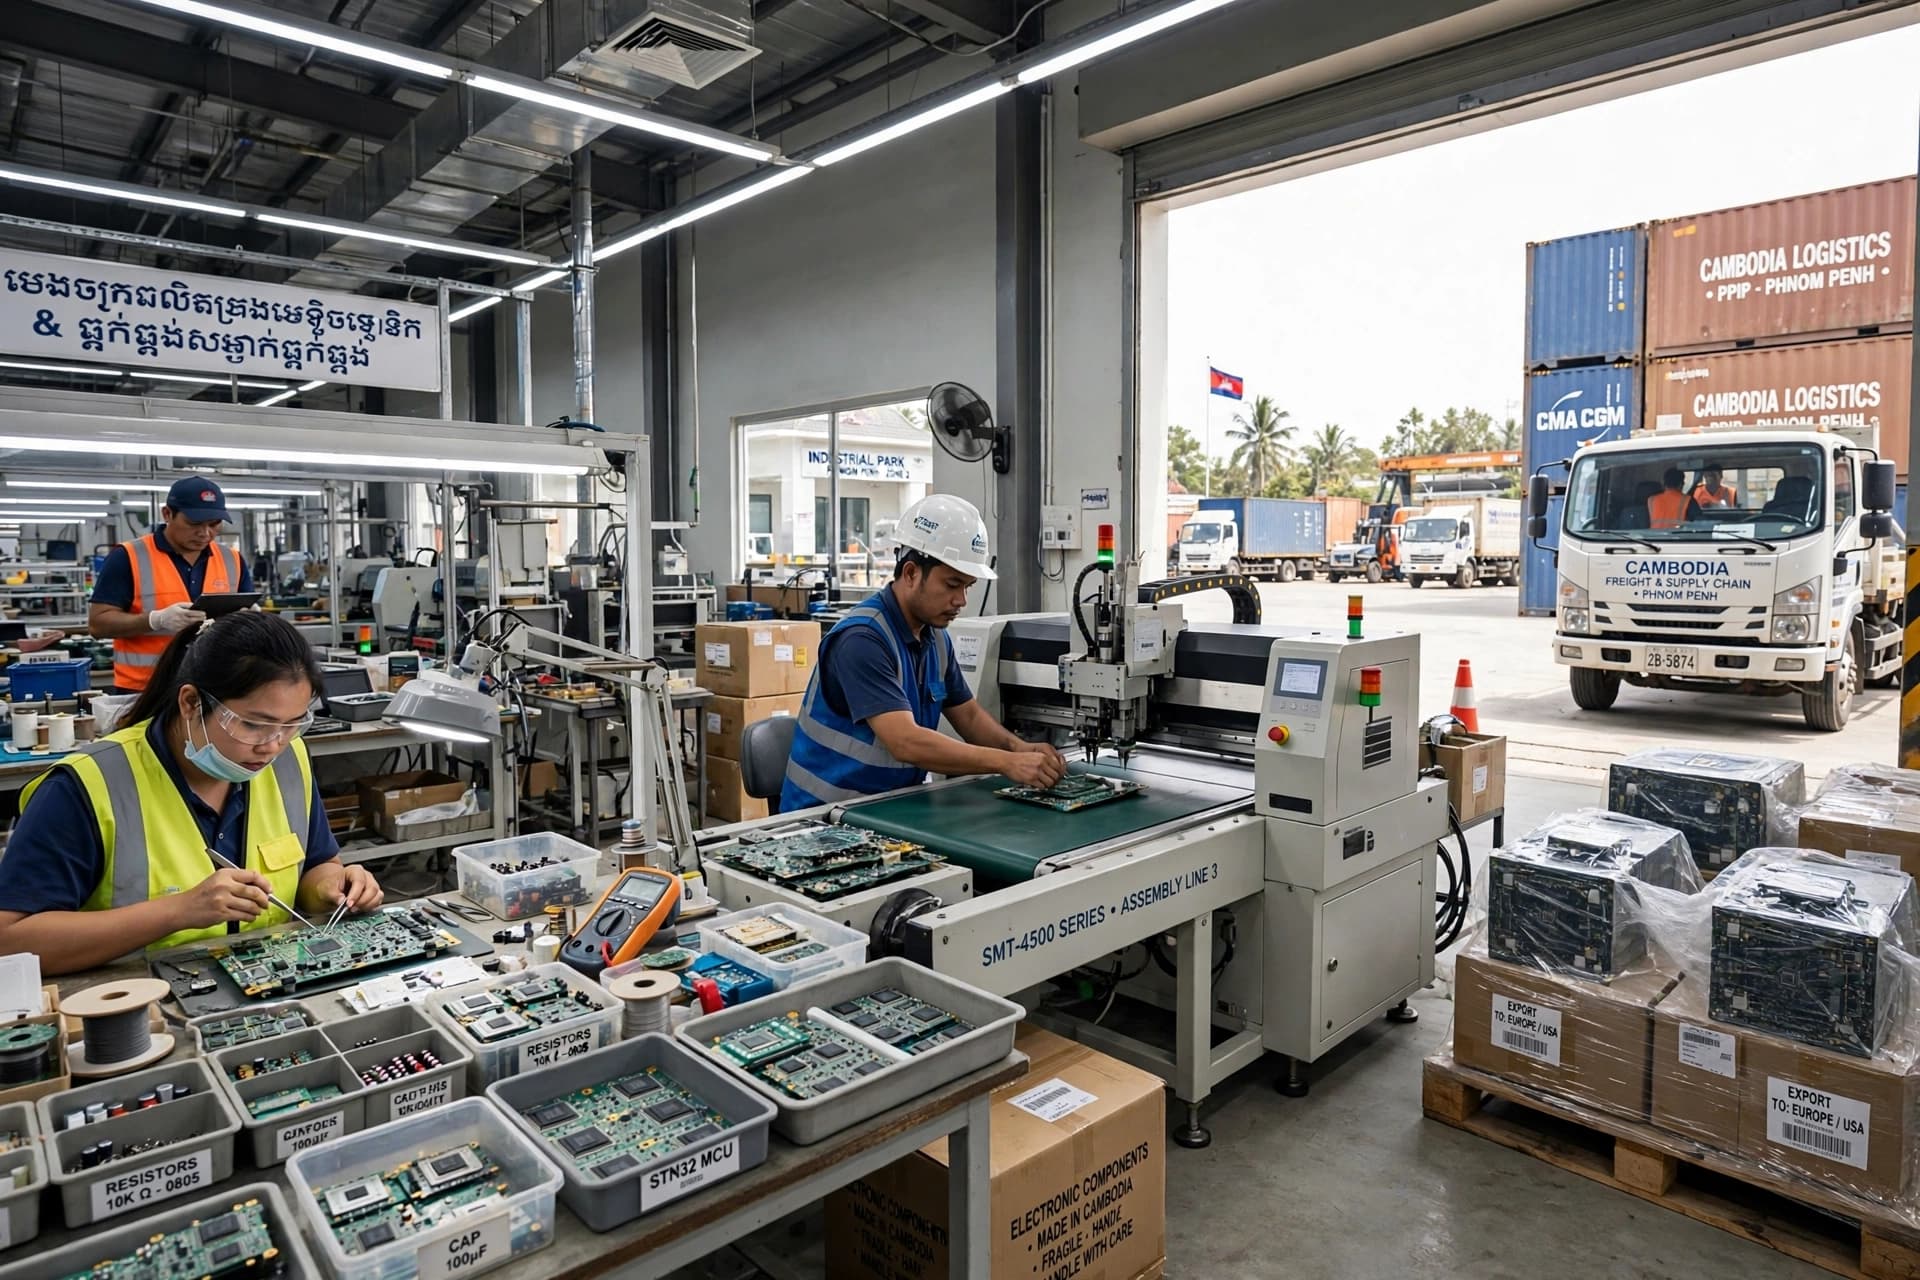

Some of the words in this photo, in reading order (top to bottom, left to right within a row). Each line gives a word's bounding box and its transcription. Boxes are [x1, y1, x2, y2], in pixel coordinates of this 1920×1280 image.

[1699, 247, 1788, 283] CAMBODIA
[1793, 231, 1892, 270] LOGISTICS
[1717, 281, 1751, 302] PPIP
[1765, 271, 1824, 295] PHNOM
[1828, 264, 1875, 288] PENH
[32, 308, 63, 338] &
[1693, 389, 1779, 417] CAMBODIA
[1784, 381, 1881, 412] LOGISTICS
[1536, 409, 1578, 431] CMA
[1580, 405, 1625, 428] CGM
[808, 451, 874, 466] INDSTRIAL
[877, 455, 905, 467] PARK
[1605, 577, 1652, 587] FREIGHT
[1655, 578, 1663, 587] &
[1666, 578, 1710, 588] SUPPLY
[1713, 579, 1751, 589] CHAIN
[1625, 560, 1729, 576] CAMBODIA
[1642, 590, 1683, 600] PHNOM
[1686, 591, 1718, 600] PENH
[982, 924, 1054, 967] SMT-4500
[1059, 905, 1106, 938] SERIES
[1120, 877, 1183, 915] ASSEMBLY
[1185, 866, 1209, 890] LINE
[1211, 863, 1218, 879] 3
[527, 1028, 591, 1057] RESISTORS
[1507, 1014, 1537, 1031] EUROPE
[1542, 1024, 1558, 1038] USA
[1788, 1086, 1831, 1109] EXPORT
[1772, 1098, 1790, 1113] TO:
[1792, 1103, 1834, 1126] EUROPE
[1843, 1118, 1864, 1135] USA
[106, 1158, 198, 1195] RESISTORS
[650, 1158, 697, 1189] STN32
[701, 1142, 733, 1168] MCU
[106, 1191, 135, 1211] 10K
[165, 1171, 200, 1192] 0805
[1010, 1183, 1080, 1240] ELECTRONIC
[1083, 1141, 1149, 1196] COMPONENTS
[1037, 1216, 1068, 1251] MADE
[1070, 1208, 1080, 1229] IN
[1083, 1176, 1133, 1220] CAMBODIA
[446, 1243, 487, 1271] 100µF
[448, 1230, 481, 1253] CAP
[1041, 1232, 1082, 1272] FRAGILE
[1083, 1236, 1107, 1267] WITH
[1109, 1218, 1134, 1248] CARE
